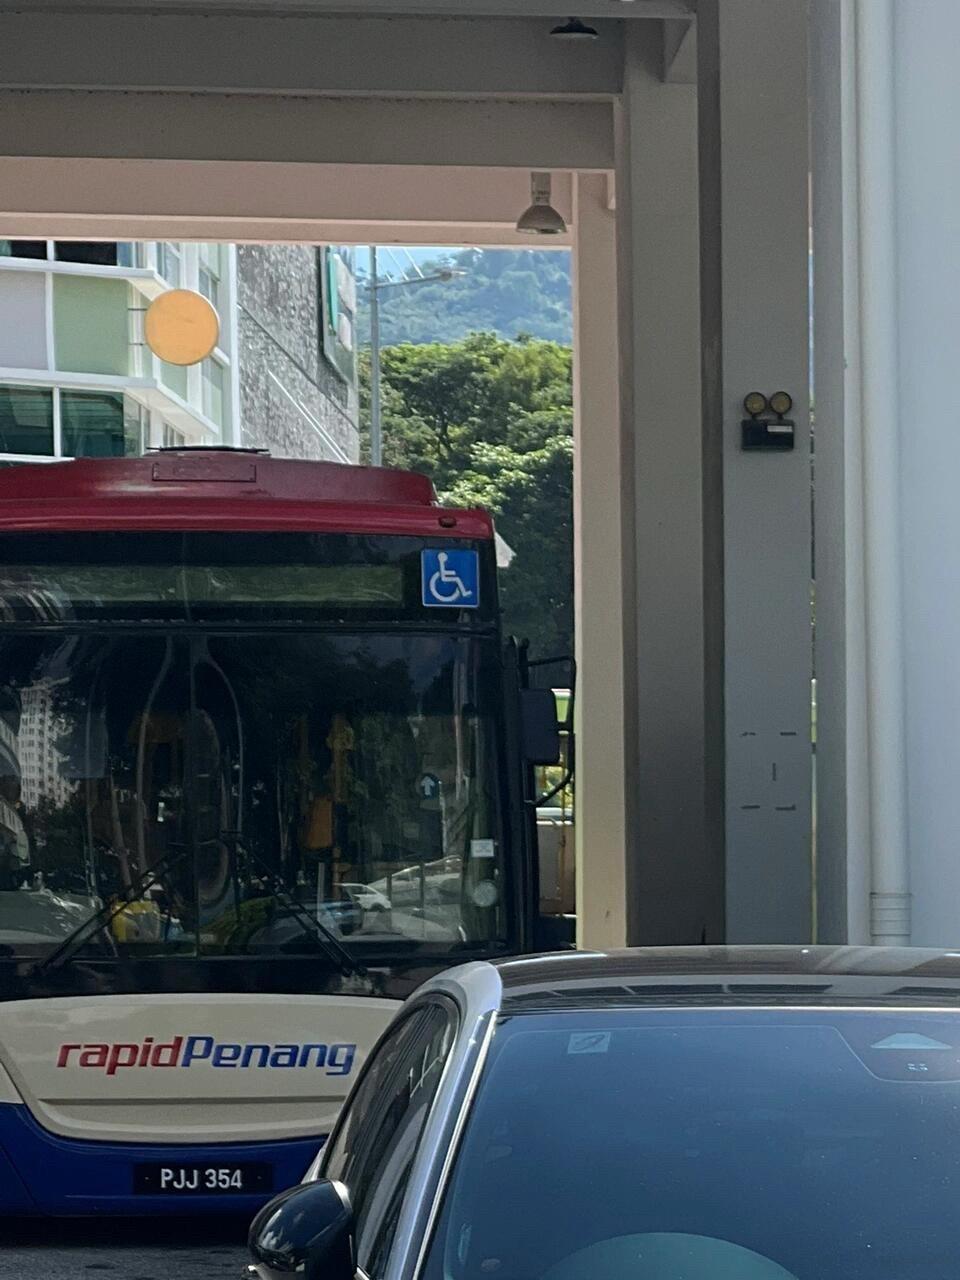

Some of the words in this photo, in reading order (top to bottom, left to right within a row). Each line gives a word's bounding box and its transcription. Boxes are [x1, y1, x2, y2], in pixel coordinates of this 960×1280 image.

[56, 1035, 357, 1076] rapidPenang
[160, 1168, 199, 1189] PJJ
[204, 1168, 242, 1189] 354
